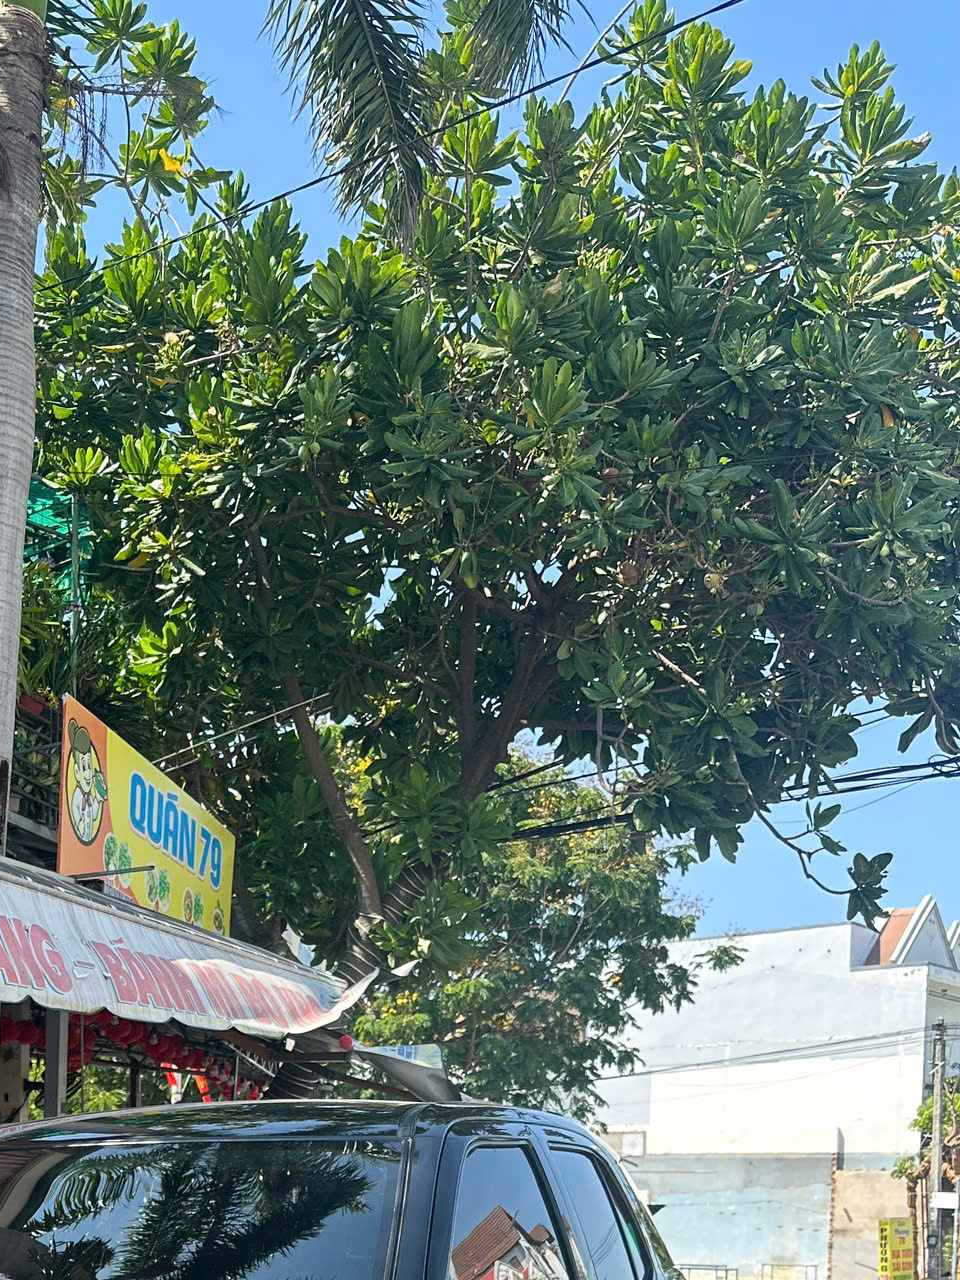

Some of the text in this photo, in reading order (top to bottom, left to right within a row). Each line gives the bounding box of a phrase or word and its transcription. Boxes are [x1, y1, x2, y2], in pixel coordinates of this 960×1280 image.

[129, 772, 222, 889] QUÁN 79
[90, 938, 207, 1015] BÁNH
